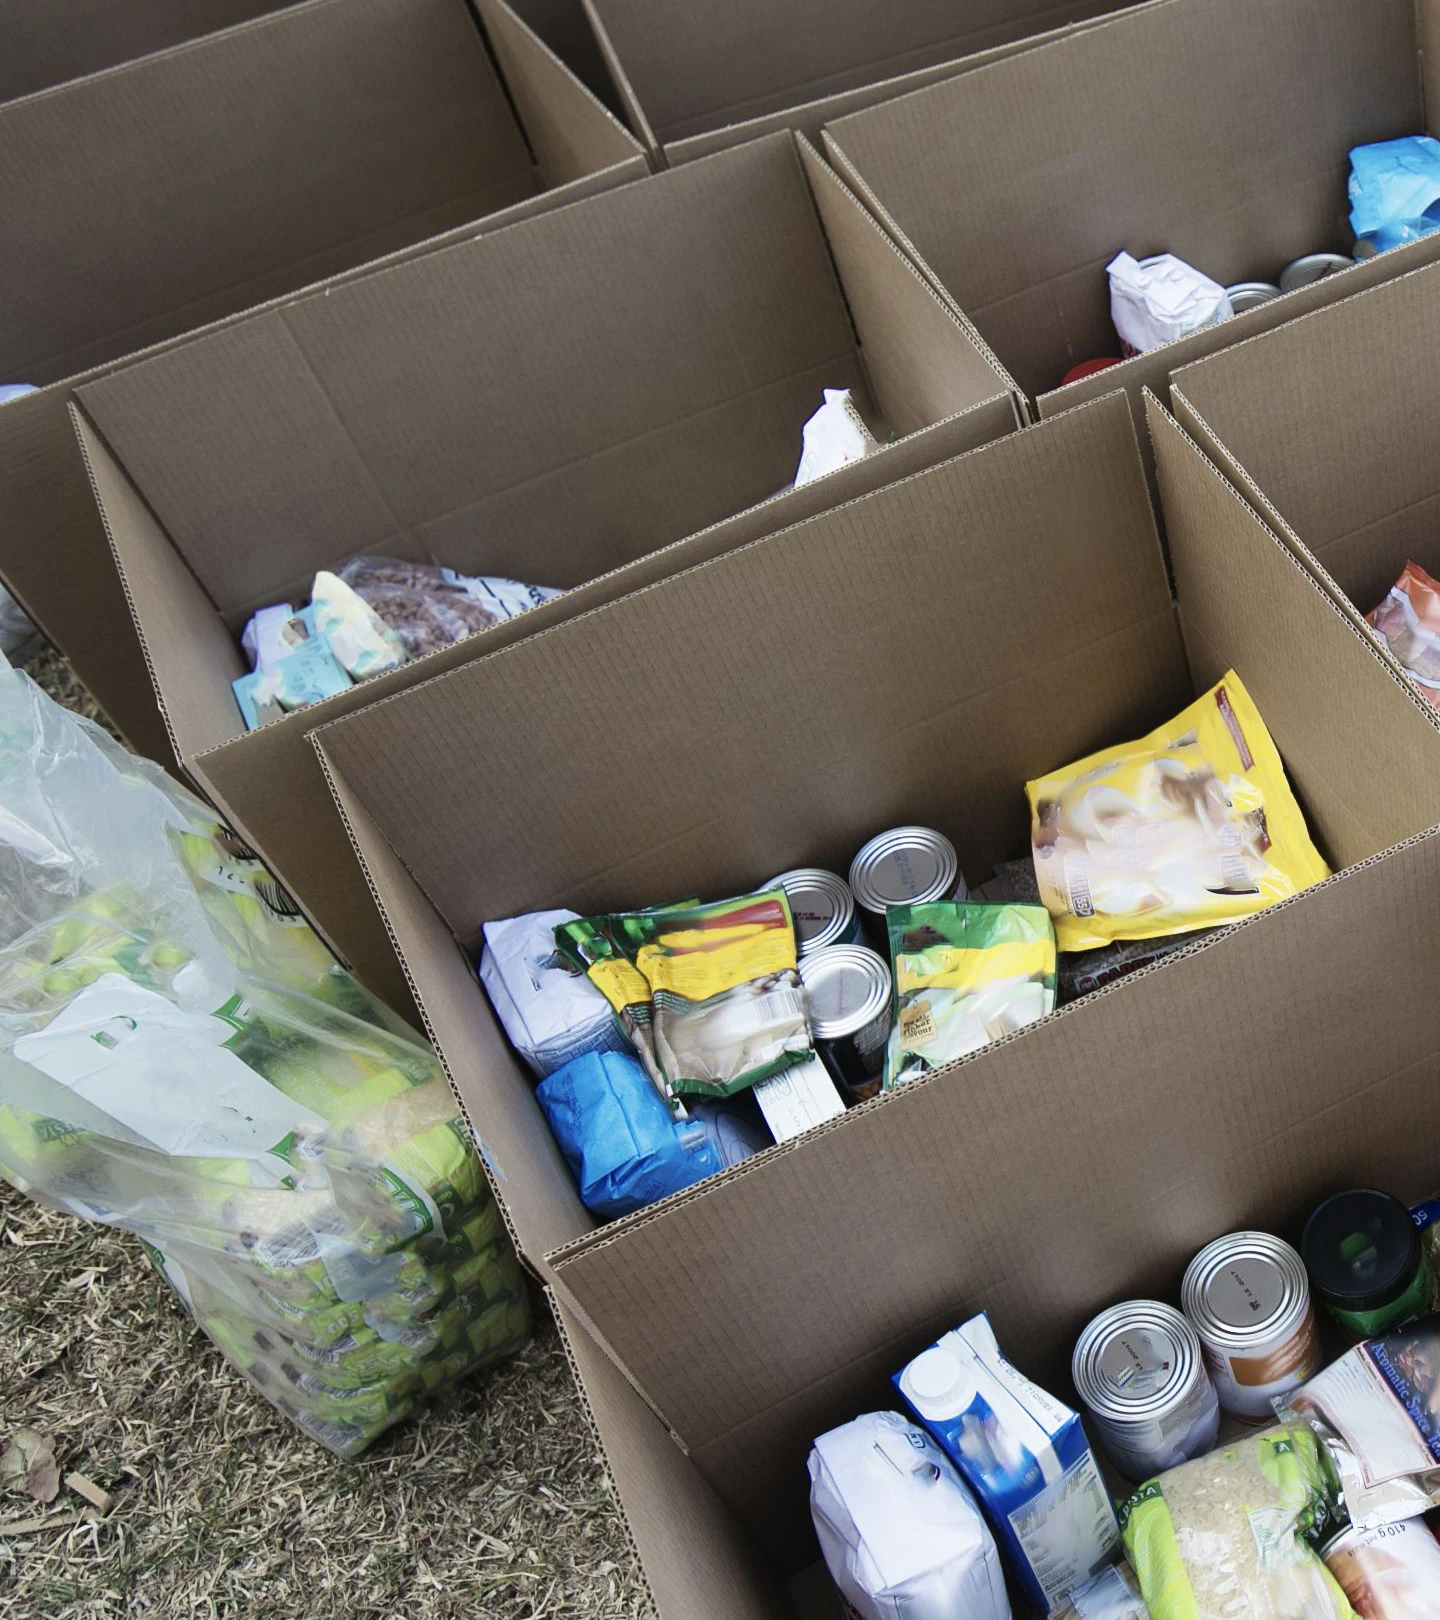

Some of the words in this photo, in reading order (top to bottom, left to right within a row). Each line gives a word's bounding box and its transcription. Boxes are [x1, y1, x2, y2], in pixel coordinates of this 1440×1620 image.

[1371, 1342, 1410, 1399] Aromatic
[1405, 1394, 1431, 1433] Spice
[1377, 1527, 1386, 1538] g
[1387, 1523, 1406, 1537] 410
